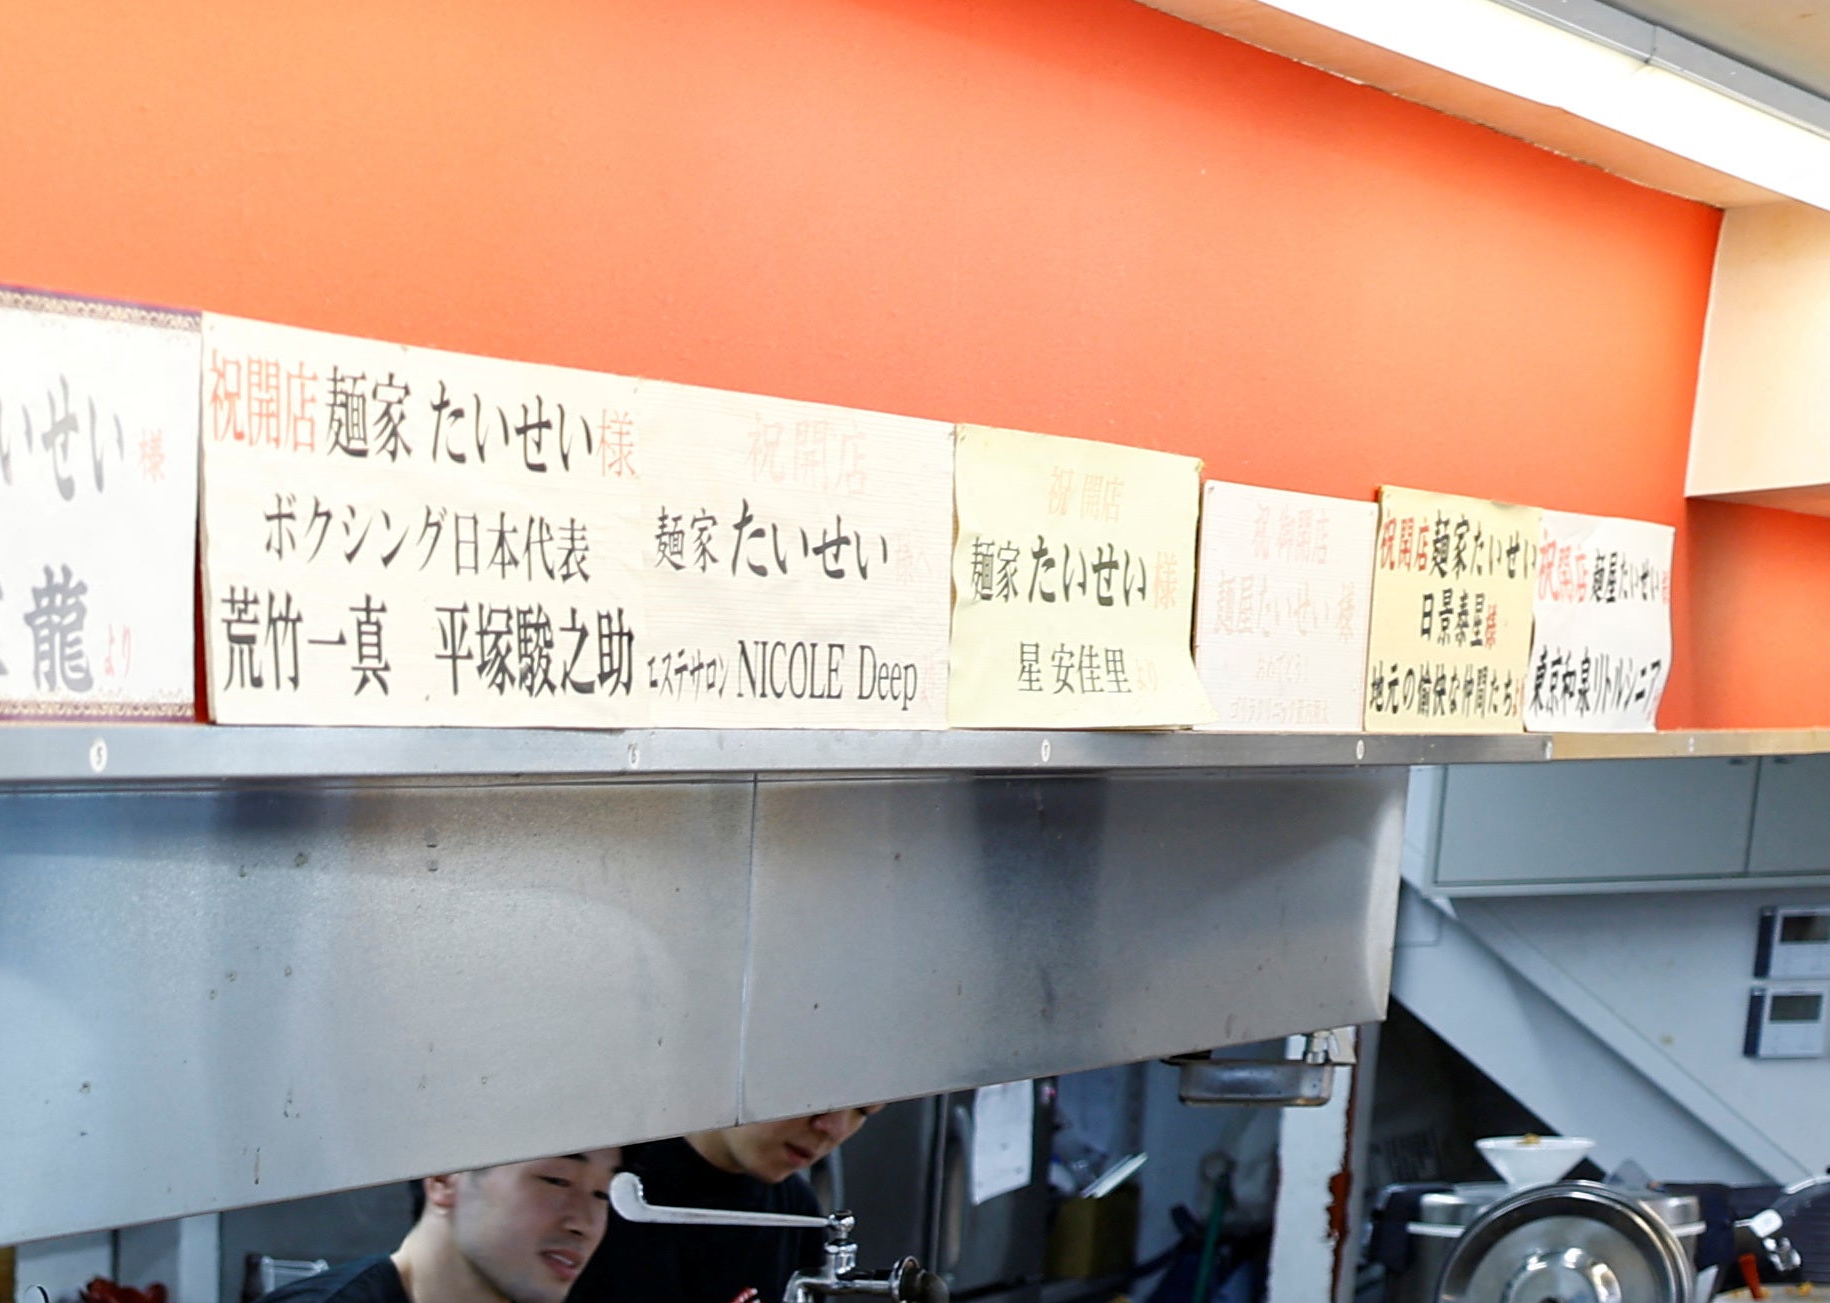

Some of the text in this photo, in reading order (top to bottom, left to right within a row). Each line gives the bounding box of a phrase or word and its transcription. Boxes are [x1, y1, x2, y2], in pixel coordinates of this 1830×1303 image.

[262, 492, 593, 584] ボクシング日本代表
[219, 584, 391, 697] 荒竹一真
[737, 640, 845, 700] NICOLE
[856, 644, 919, 711] Deep
